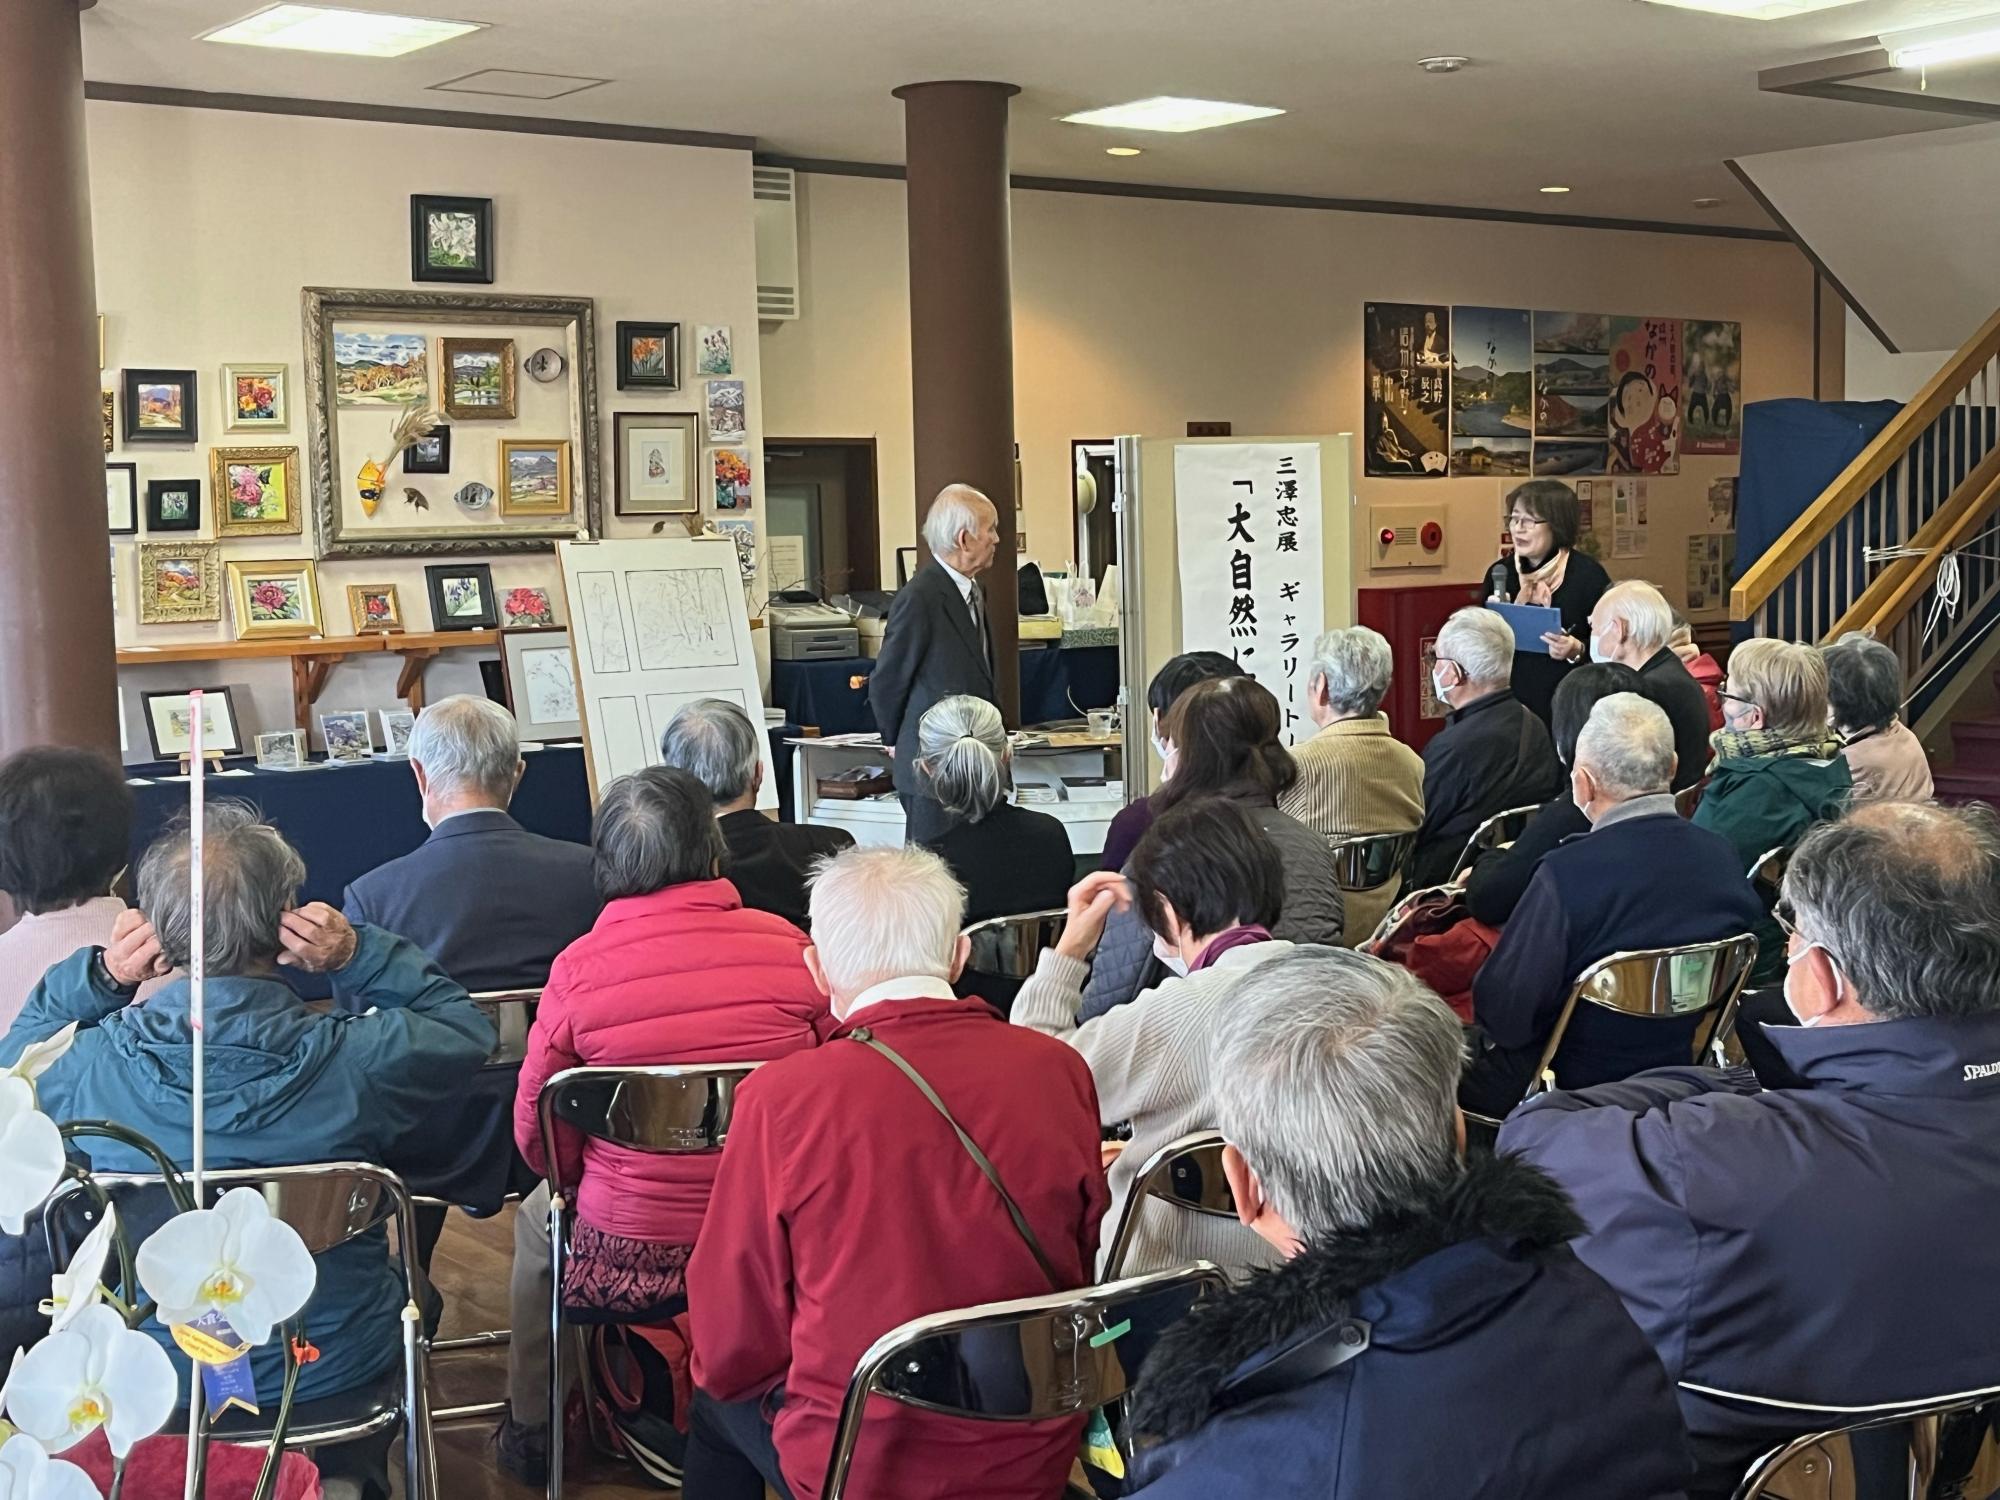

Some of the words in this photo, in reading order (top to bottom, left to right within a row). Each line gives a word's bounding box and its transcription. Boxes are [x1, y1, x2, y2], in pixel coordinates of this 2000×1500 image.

[1644, 319, 1658, 380] なかの
[1275, 456, 1299, 553] 三澤忠展
